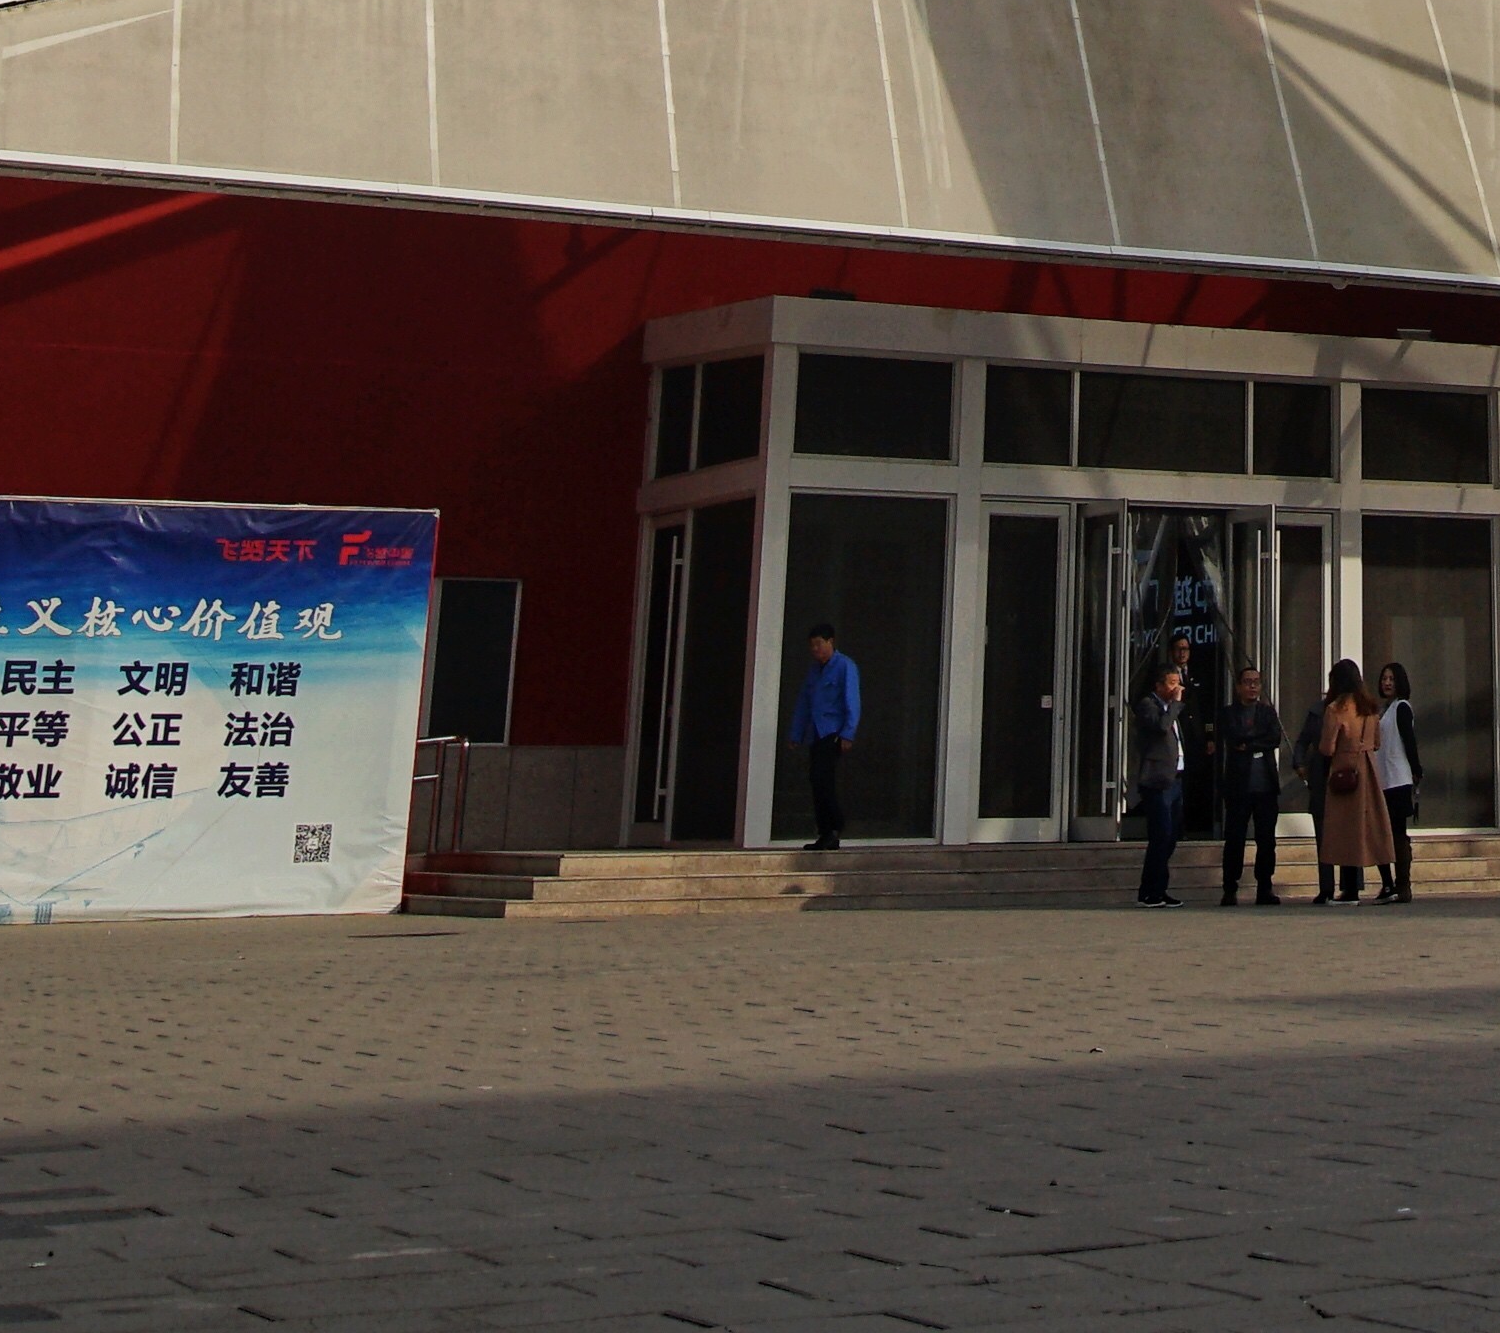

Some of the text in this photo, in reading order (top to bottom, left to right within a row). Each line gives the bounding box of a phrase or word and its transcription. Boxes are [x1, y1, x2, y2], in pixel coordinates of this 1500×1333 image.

[1, 659, 75, 696] 民主
[117, 660, 189, 696] 文明
[230, 662, 301, 697] 和谐
[112, 712, 183, 747] 公正
[223, 712, 295, 747] 法治
[105, 762, 178, 799] 诚信
[218, 762, 290, 798] 友善
